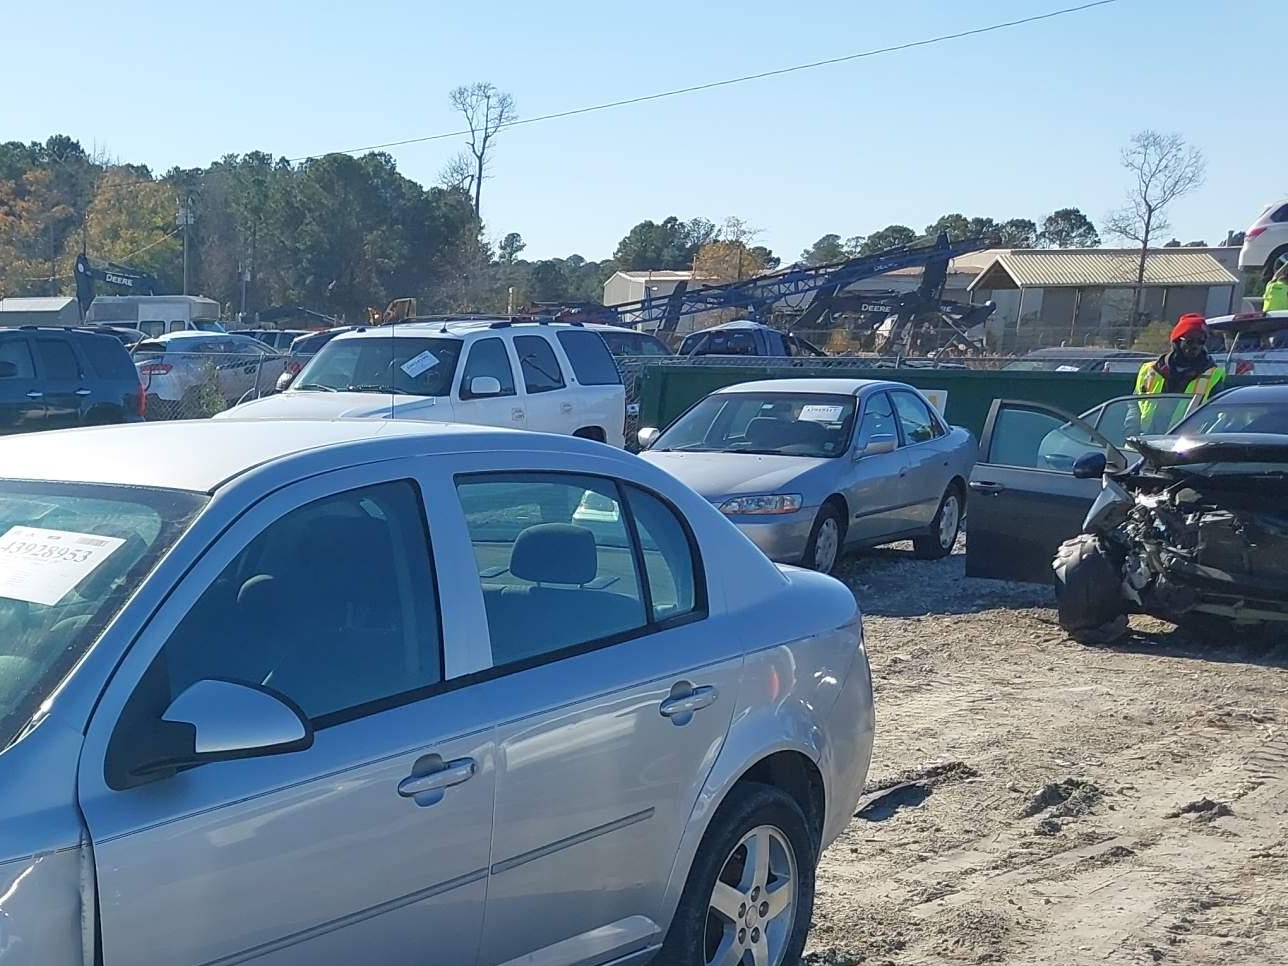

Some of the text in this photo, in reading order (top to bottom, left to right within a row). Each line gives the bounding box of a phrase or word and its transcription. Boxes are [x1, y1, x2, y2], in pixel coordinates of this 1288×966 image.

[105, 273, 133, 287] DEERE
[861, 303, 892, 313] DEERE
[0, 541, 93, 563] 43928953
